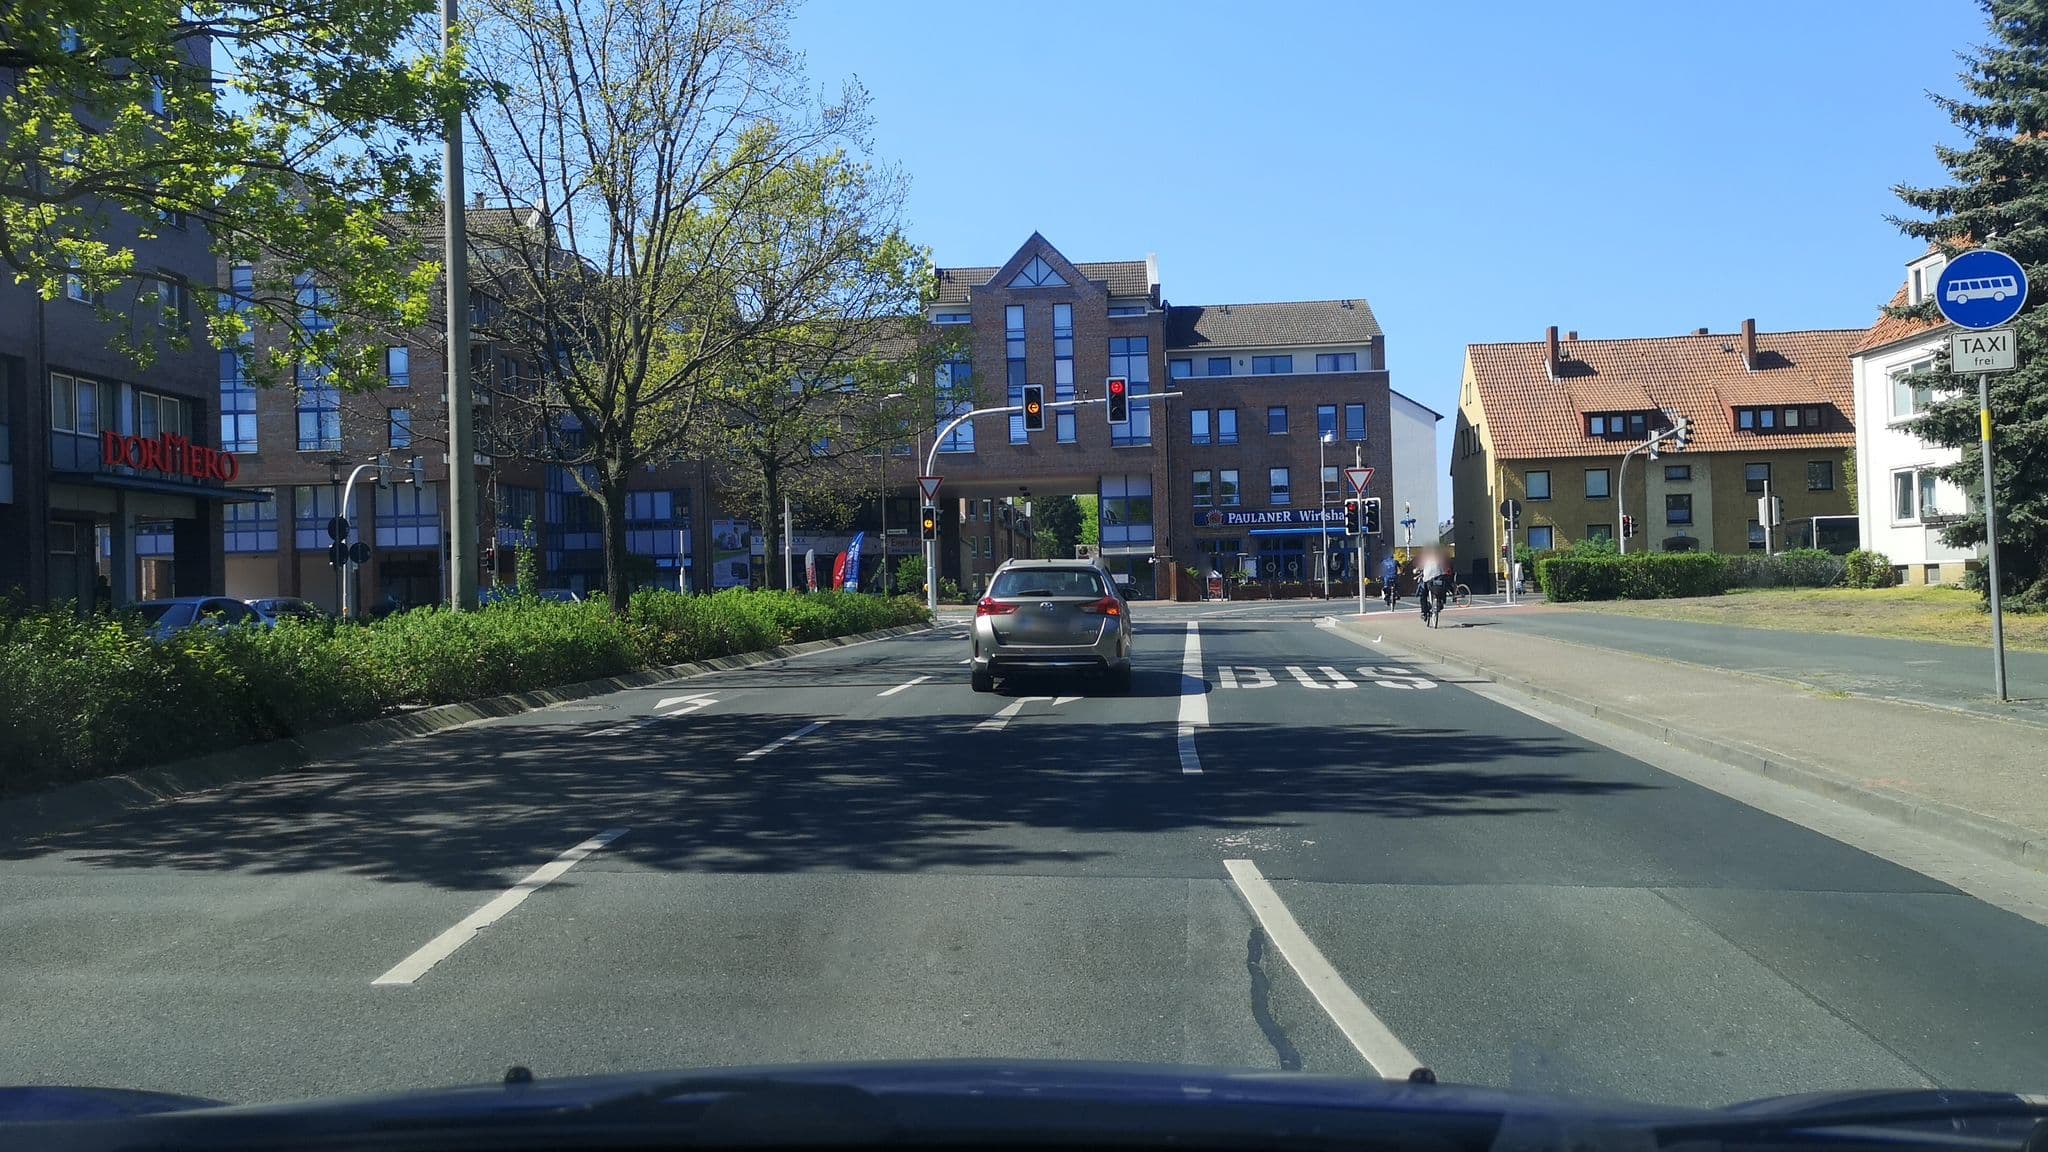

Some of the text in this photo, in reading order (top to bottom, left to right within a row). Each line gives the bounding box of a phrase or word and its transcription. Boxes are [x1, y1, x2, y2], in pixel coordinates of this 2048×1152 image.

[1960, 336, 2006, 354] TAXI
[1975, 356, 1994, 366] frei
[103, 431, 239, 482] DORMERO
[1228, 508, 1346, 524] PAULANER Wirtsha
[1217, 666, 1438, 690] BUS
